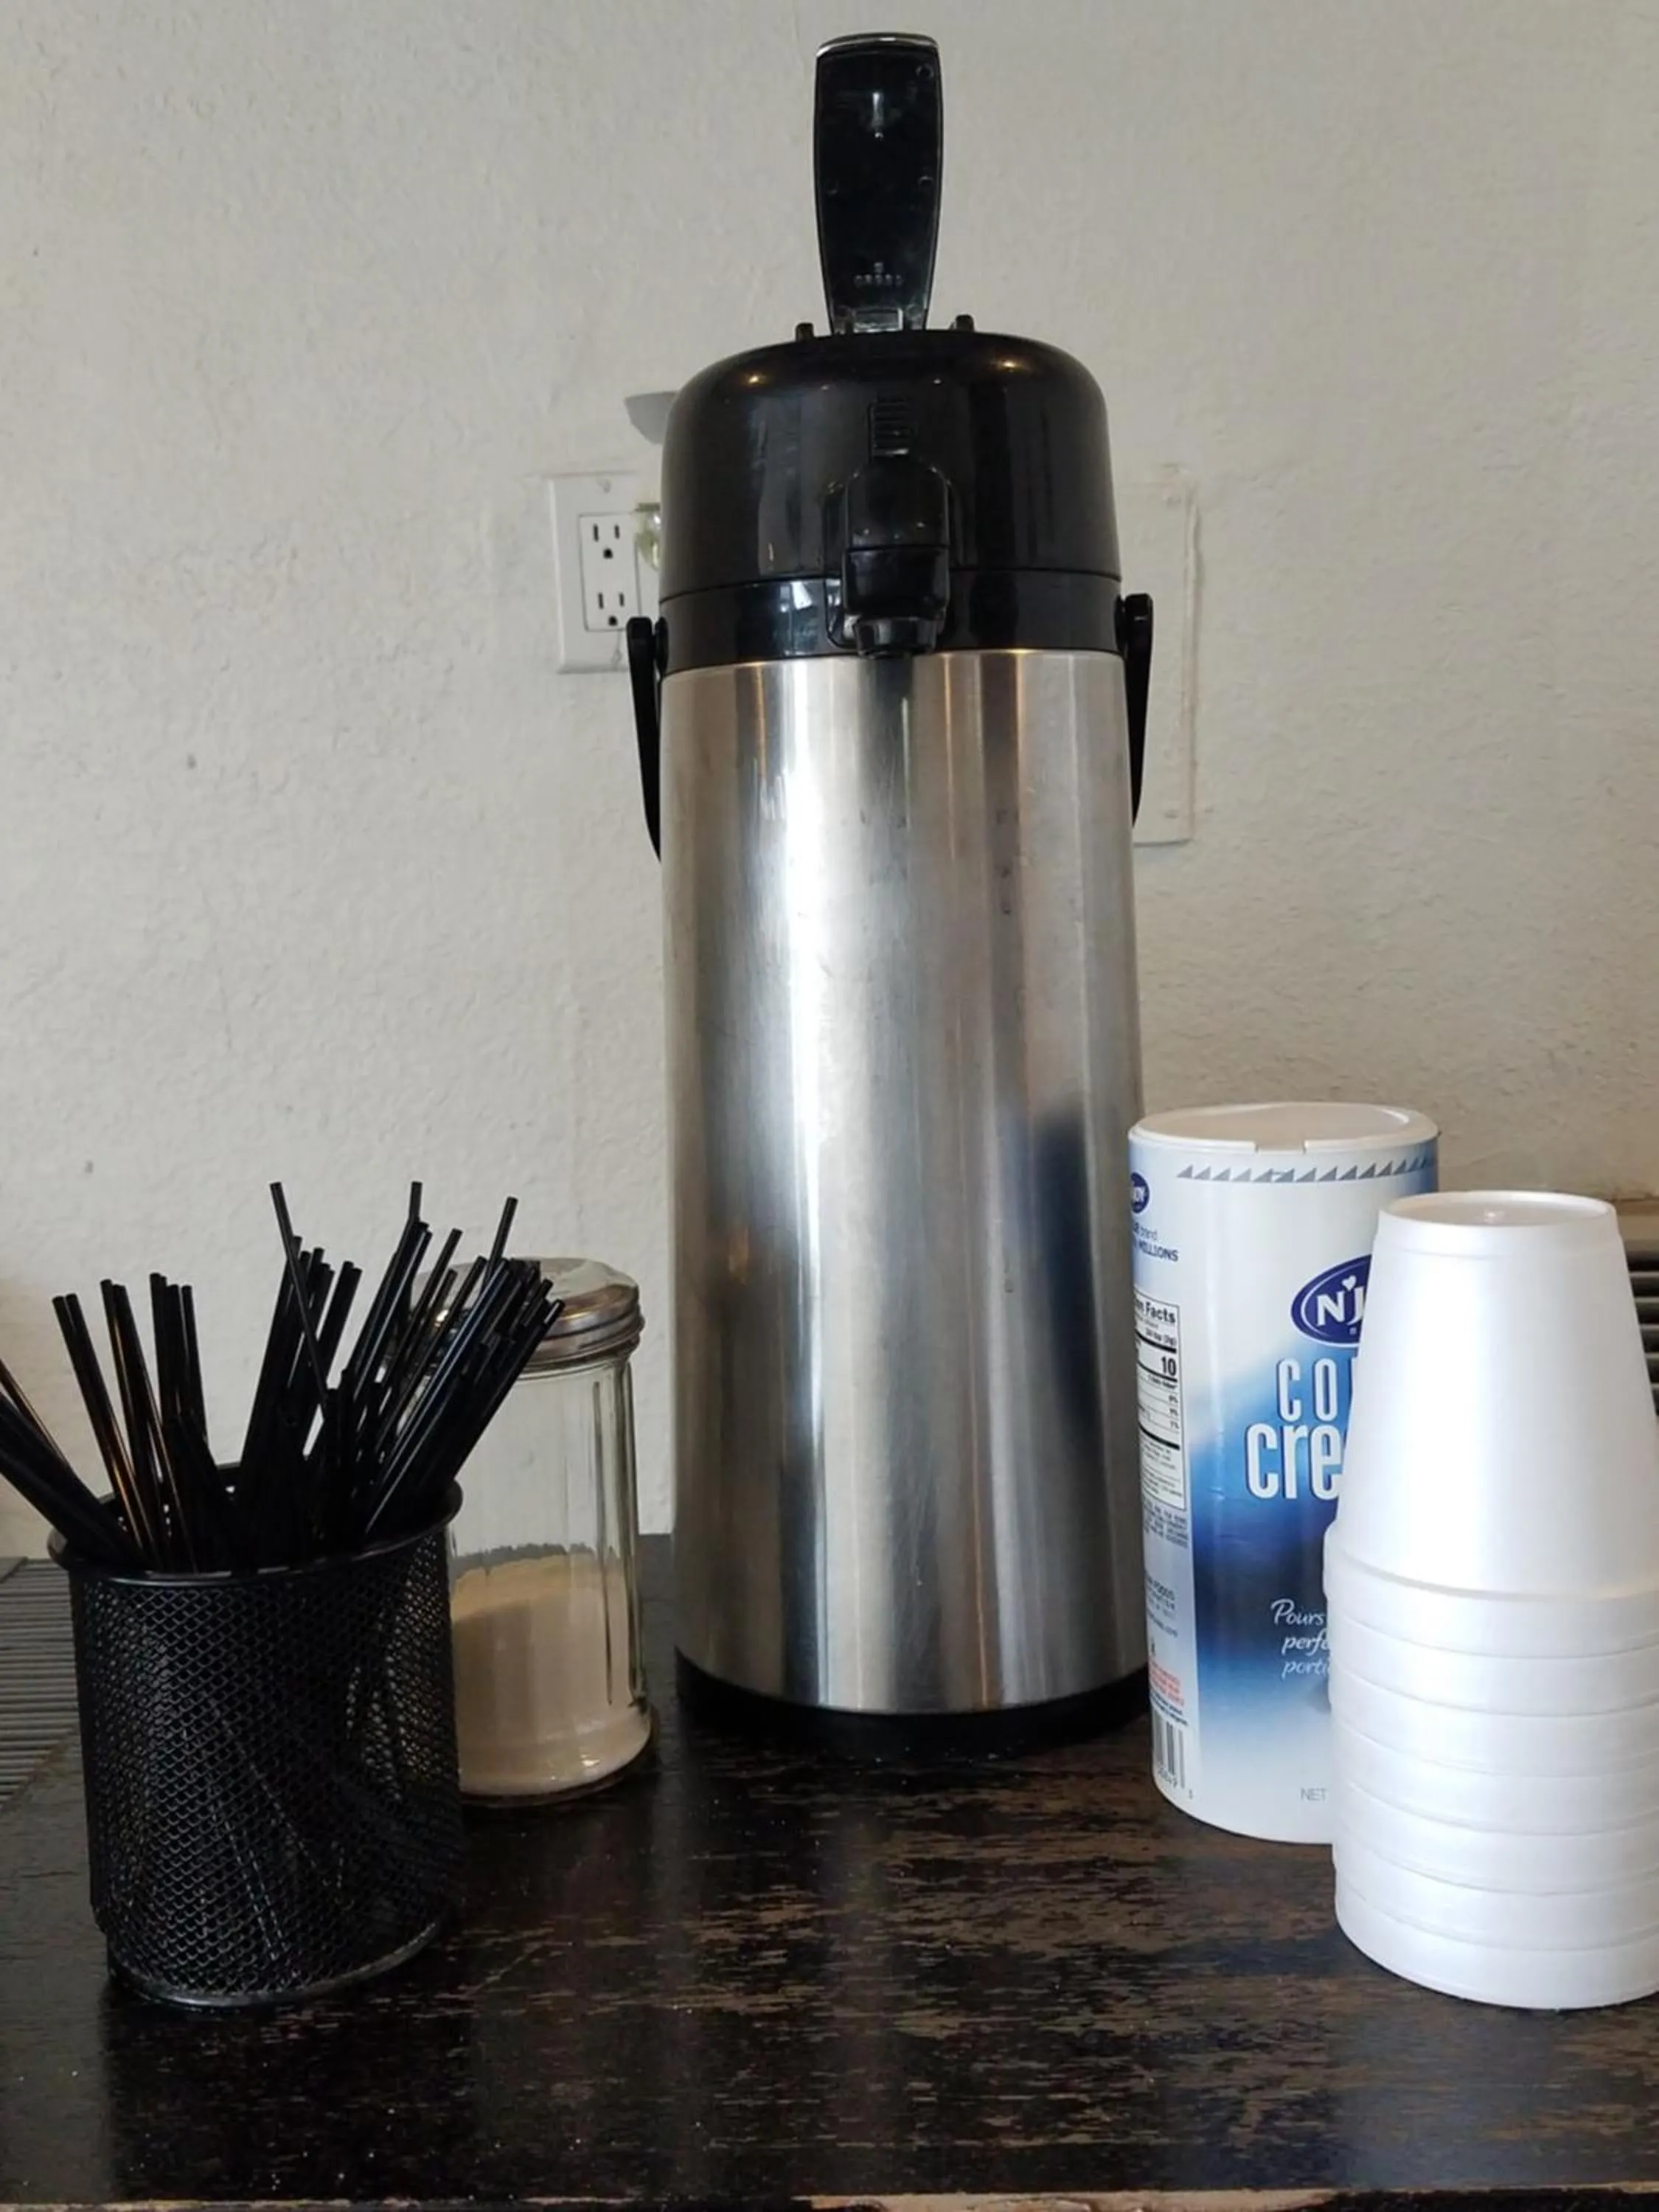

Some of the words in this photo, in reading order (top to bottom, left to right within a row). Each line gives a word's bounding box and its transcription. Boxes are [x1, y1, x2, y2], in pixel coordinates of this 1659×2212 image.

[1145, 1301, 1176, 1324] Facts
[1161, 1356, 1178, 1377] 10
[1270, 1598, 1325, 1626] Pours
[1300, 1787, 1326, 1801] NET
